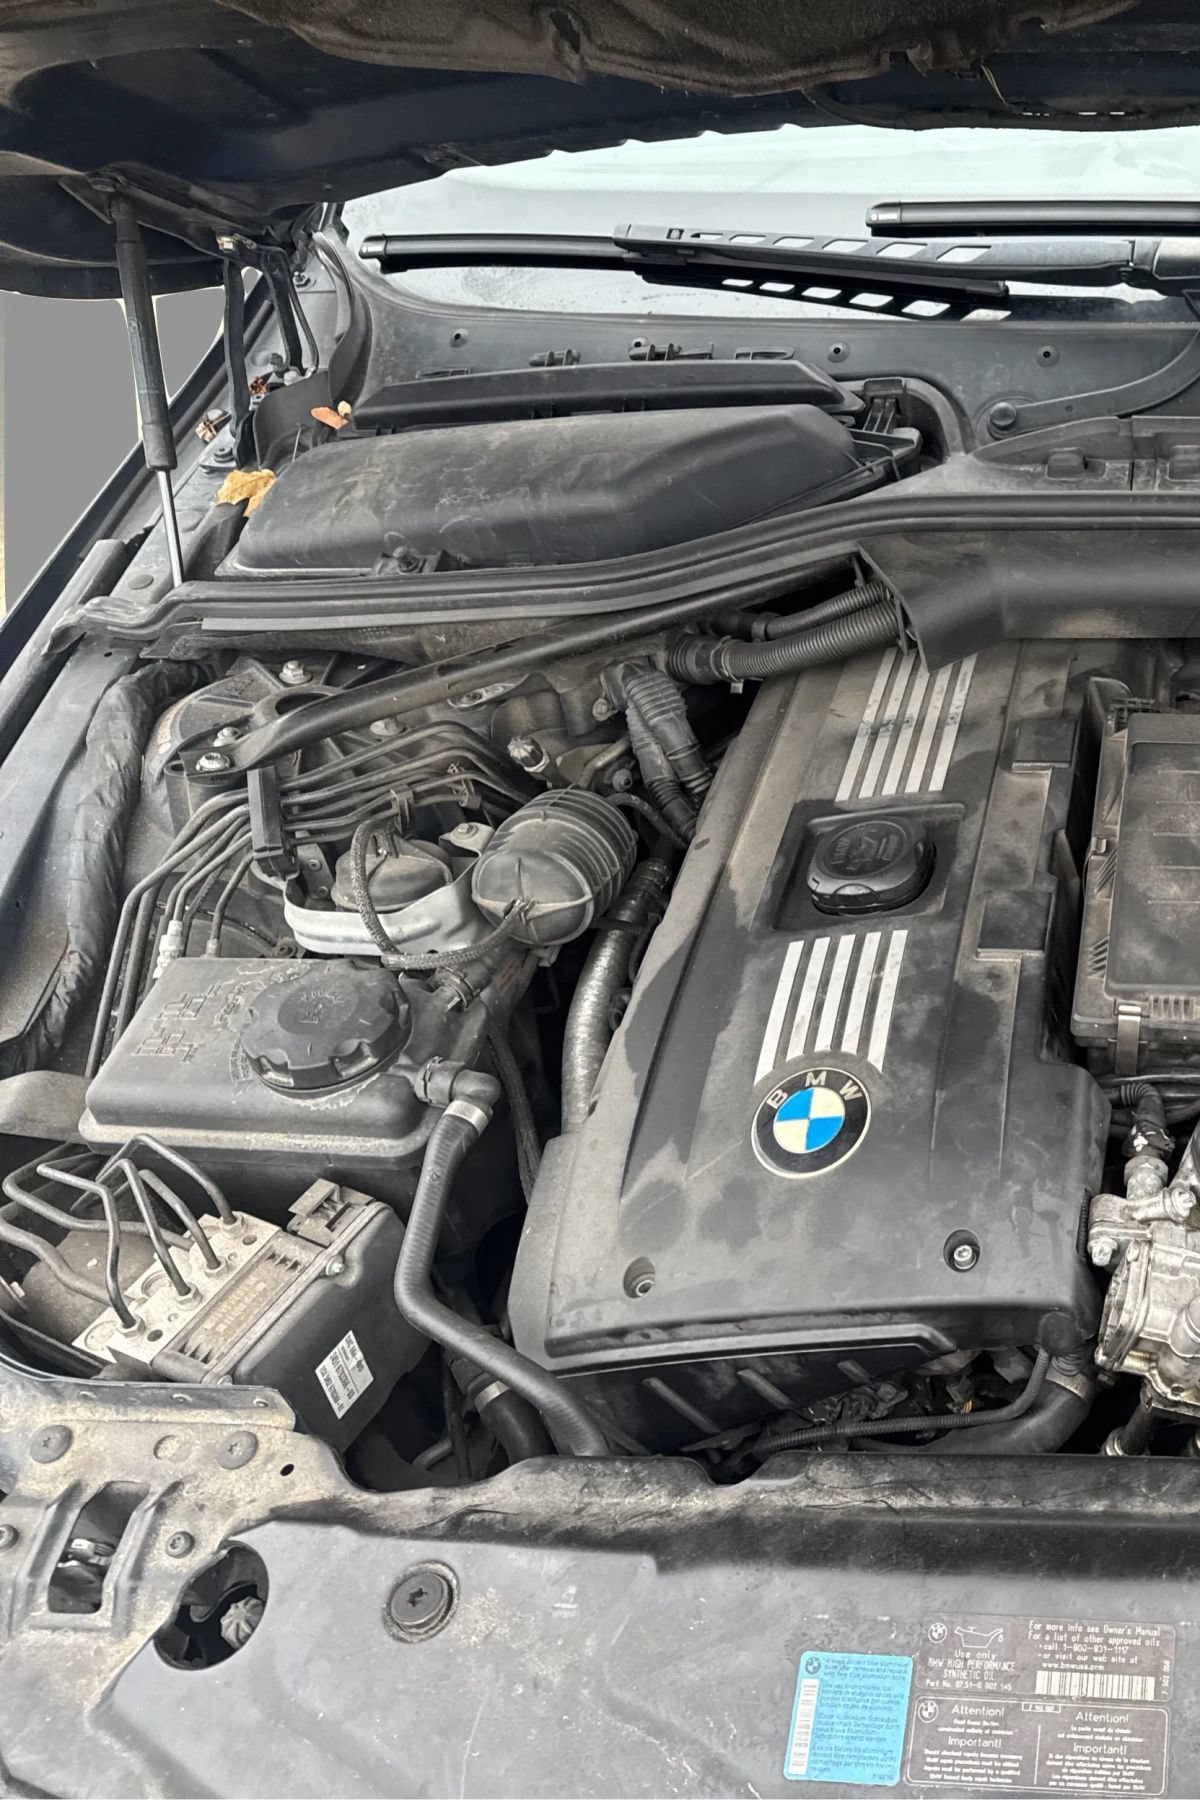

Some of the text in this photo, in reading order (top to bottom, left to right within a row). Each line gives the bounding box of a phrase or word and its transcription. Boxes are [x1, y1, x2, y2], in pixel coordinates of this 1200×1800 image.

[766, 1071, 862, 1109] BMW
[1029, 1620, 1042, 1630] For
[1045, 1623, 1063, 1631] more
[1067, 1623, 1082, 1632] info
[1103, 1624, 1131, 1635] Owner's
[1135, 1626, 1160, 1636] Manual
[1028, 1630, 1040, 1640] For
[1054, 1632, 1067, 1641] list
[1071, 1633, 1081, 1642] of
[1084, 1634, 1104, 1643] other
[1108, 1635, 1141, 1646] approved
[1145, 1637, 1160, 1647] oils
[954, 1649, 997, 1661] Use only
[1055, 1650, 1072, 1660] visit
[1092, 1653, 1107, 1663] web
[1111, 1654, 1126, 1664] site
[1129, 1655, 1138, 1665] at
[928, 1657, 944, 1668] BMW
[947, 1658, 964, 1669] HIGH
[1041, 1660, 1105, 1671] www.bmwusa.com
[943, 1669, 996, 1681] SYNTHETIC OIL
[926, 1679, 939, 1688] Part
[951, 1704, 1005, 1717] Attention!
[1075, 1711, 1129, 1723] Attention!
[948, 1735, 1002, 1748] Important!
[1073, 1742, 1128, 1755] Important!
